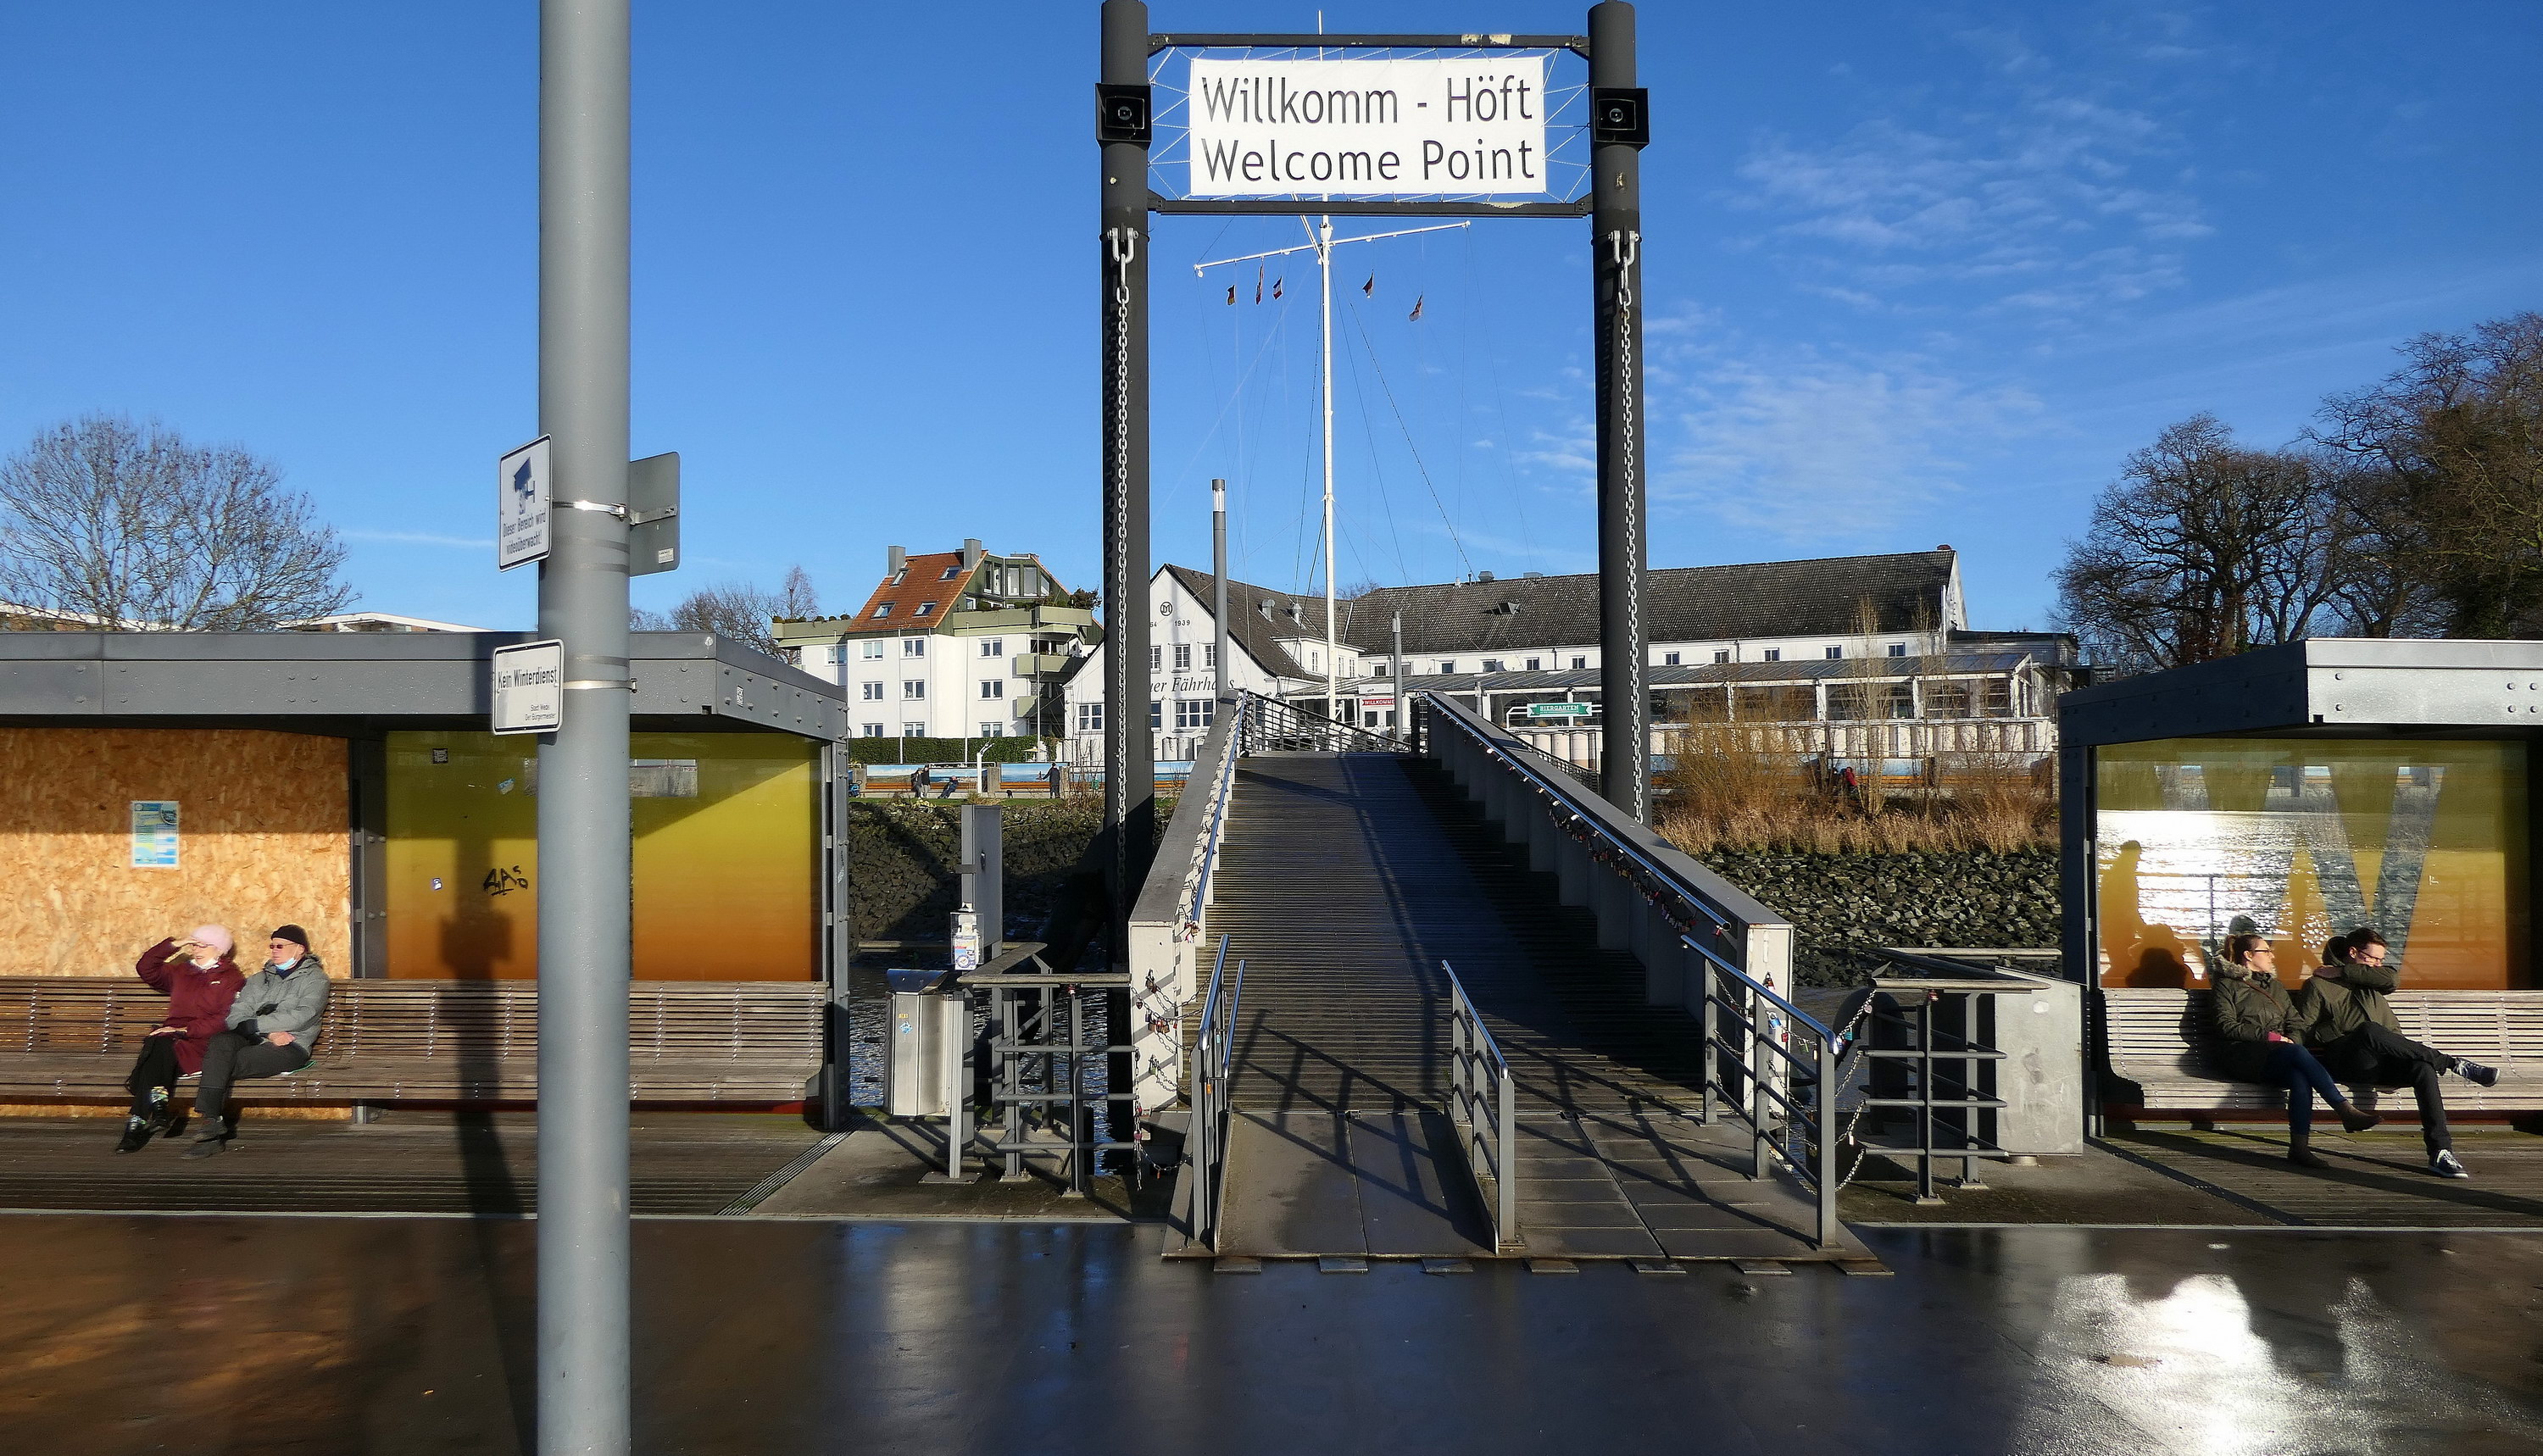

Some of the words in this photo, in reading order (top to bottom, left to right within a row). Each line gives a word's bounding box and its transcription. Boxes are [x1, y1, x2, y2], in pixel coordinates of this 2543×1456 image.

[1200, 76, 1399, 124] Willkomm
[1447, 75, 1533, 122] Höft
[1201, 138, 1400, 182] Welcome
[1423, 139, 1535, 181] Point
[504, 523, 516, 537] Dieser
[518, 513, 534, 531] Bereich
[536, 508, 546, 525] wird
[498, 670, 512, 689] Kein
[514, 665, 557, 687] Winterdienst
